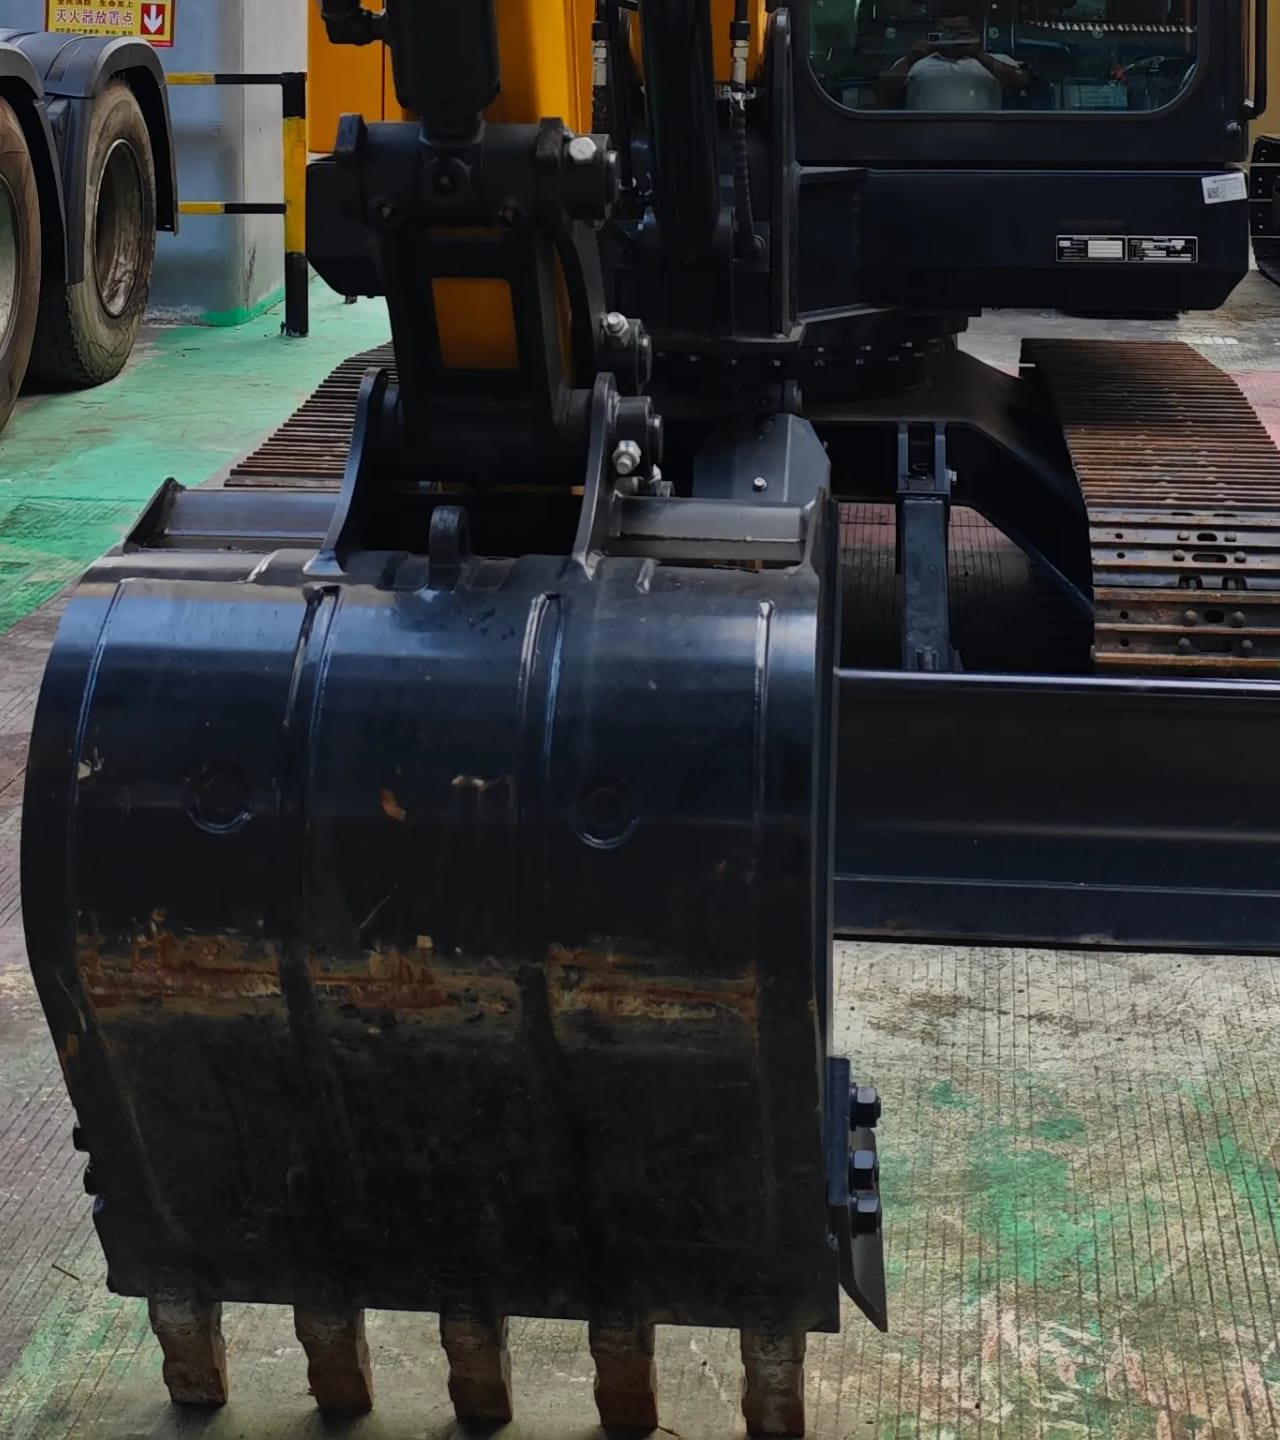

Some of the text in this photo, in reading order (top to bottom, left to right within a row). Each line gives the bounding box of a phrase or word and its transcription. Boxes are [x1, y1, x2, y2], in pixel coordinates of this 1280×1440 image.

[55, 8, 134, 26] 灭火器放置点
